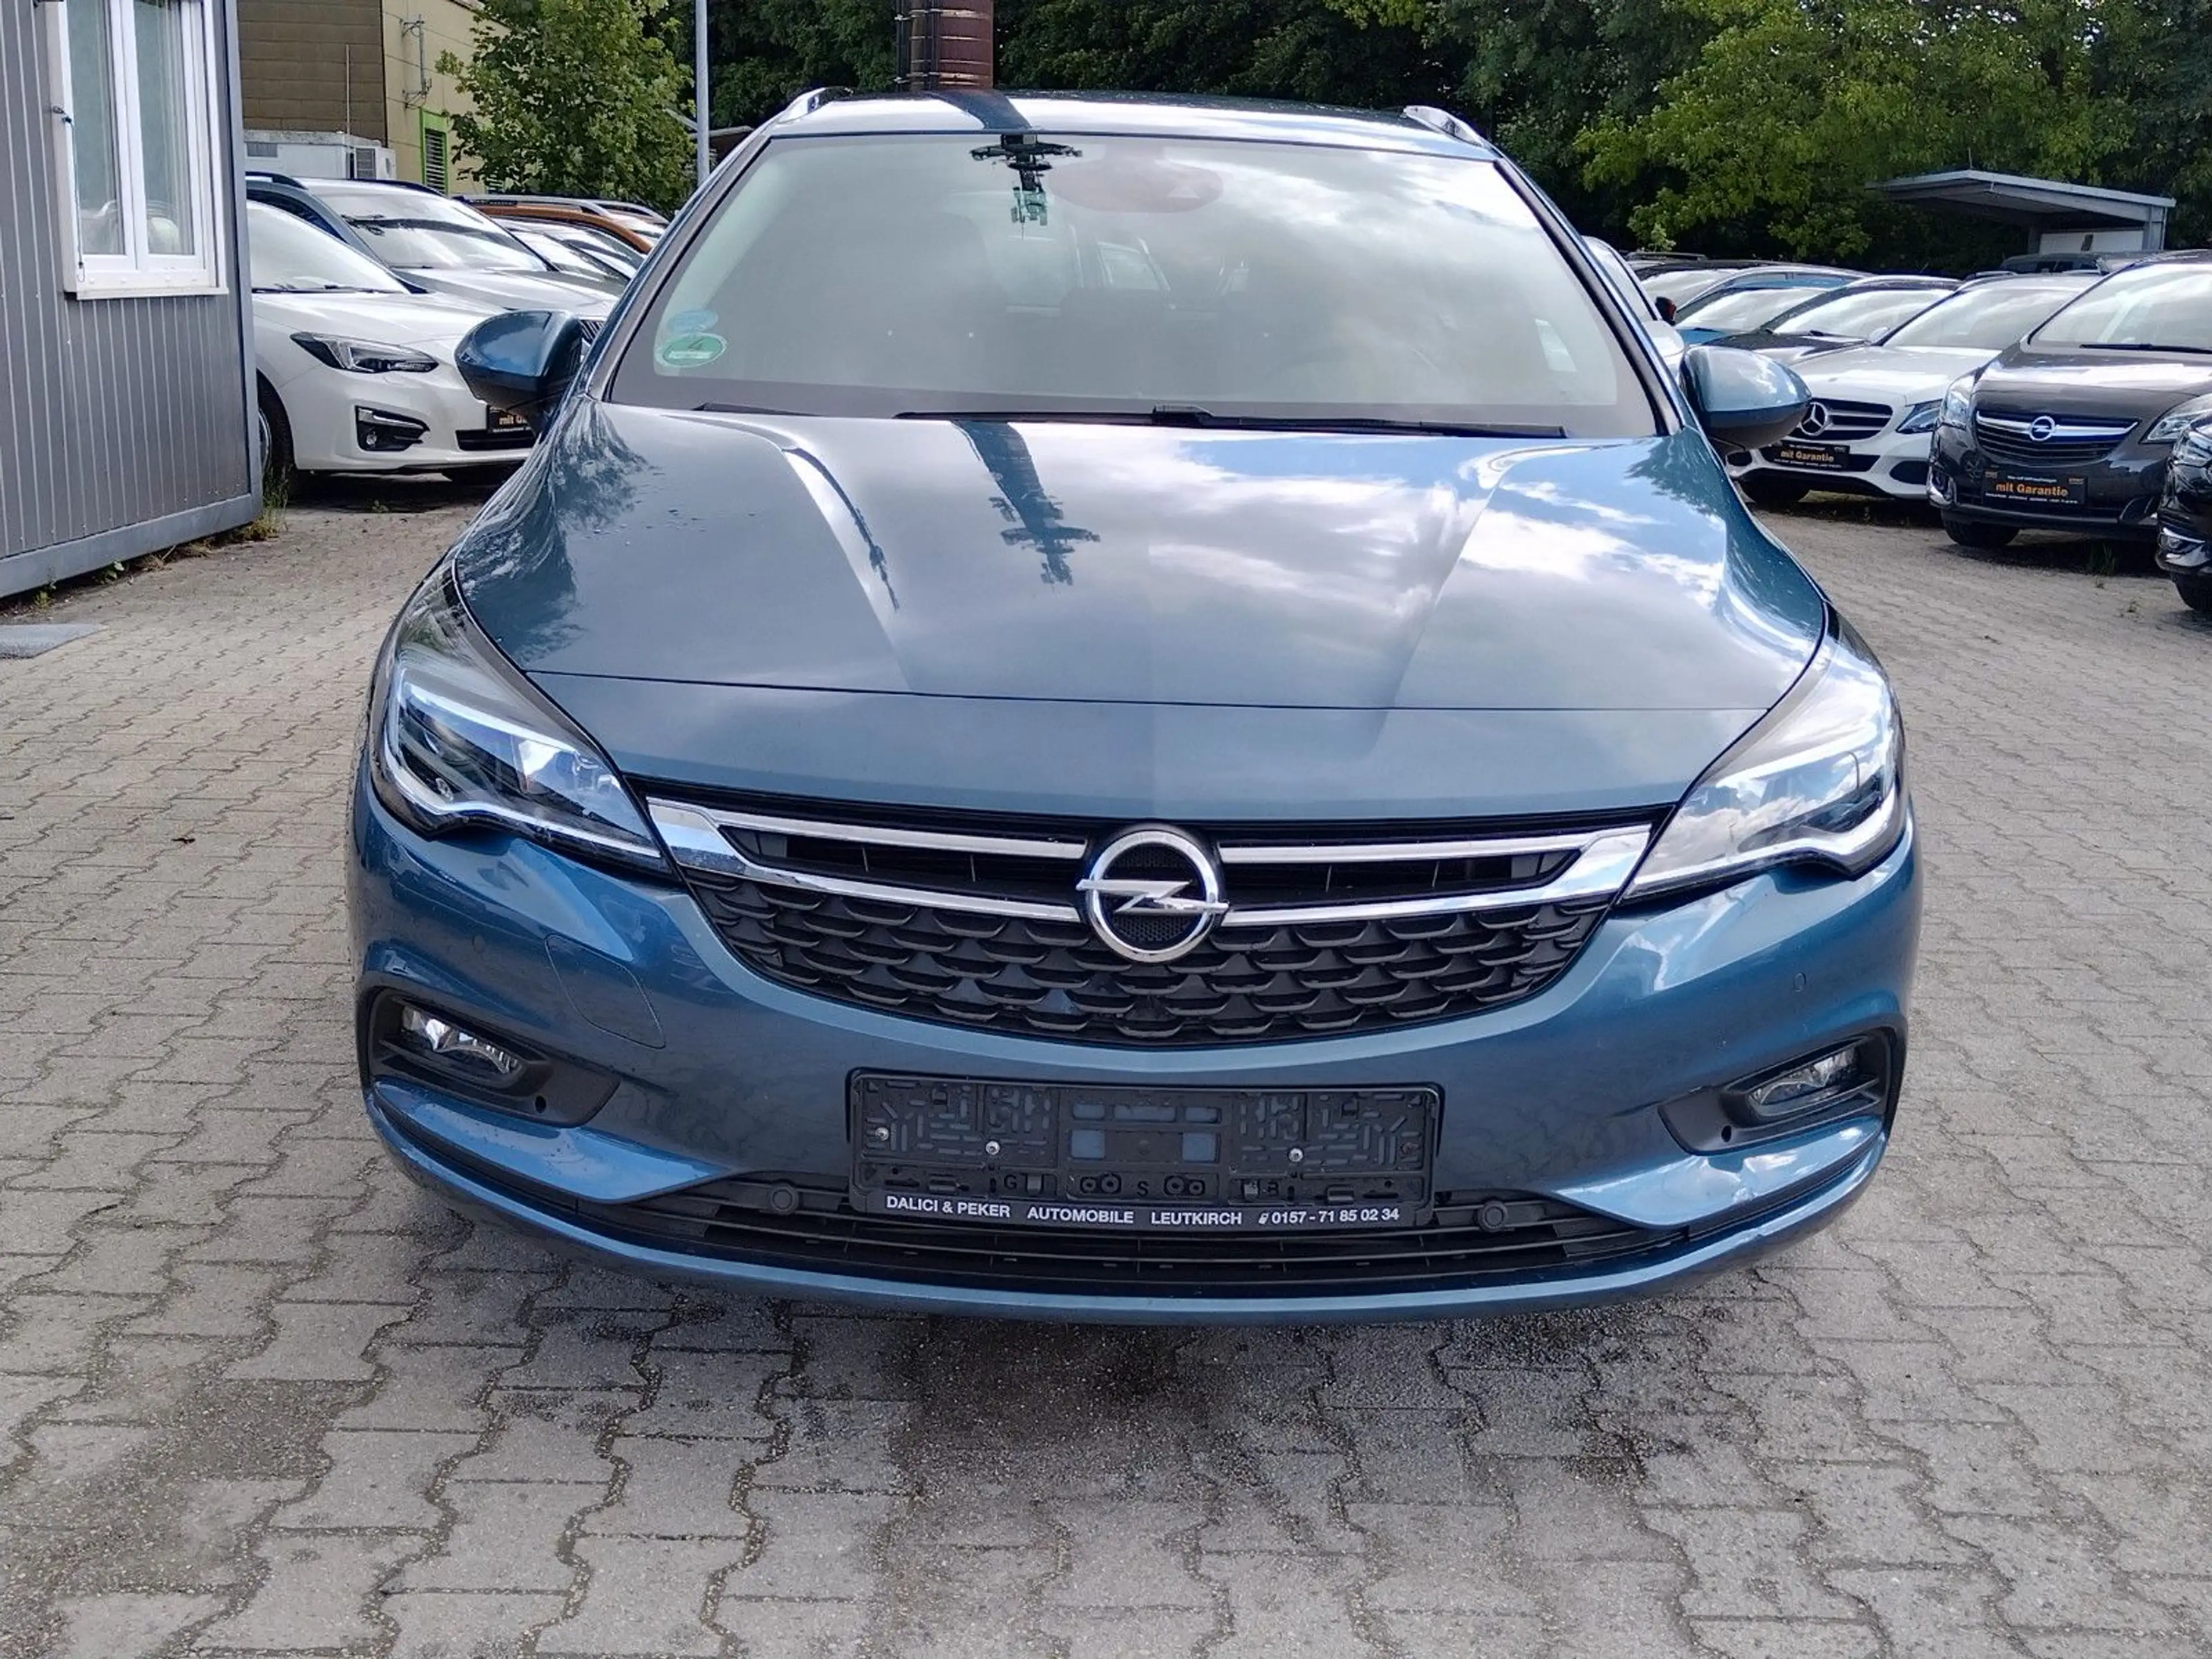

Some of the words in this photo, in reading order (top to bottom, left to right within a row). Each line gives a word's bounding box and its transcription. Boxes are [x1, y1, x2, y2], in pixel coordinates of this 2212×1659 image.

[1996, 482, 2014, 492] mit
[2017, 483, 2069, 497] Garantie
[887, 1195, 938, 1212] DALICI
[943, 1201, 953, 1213] &
[957, 1202, 1010, 1218] PEKER
[1027, 1207, 1134, 1224] AUTOMOBILE
[1151, 1211, 1242, 1225] LEUTKIRCH
[1271, 1211, 1307, 1224] 0157
[1319, 1210, 1335, 1223] 71
[1339, 1210, 1357, 1222] 85
[1360, 1209, 1378, 1221] 02
[1381, 1207, 1400, 1221] 34
